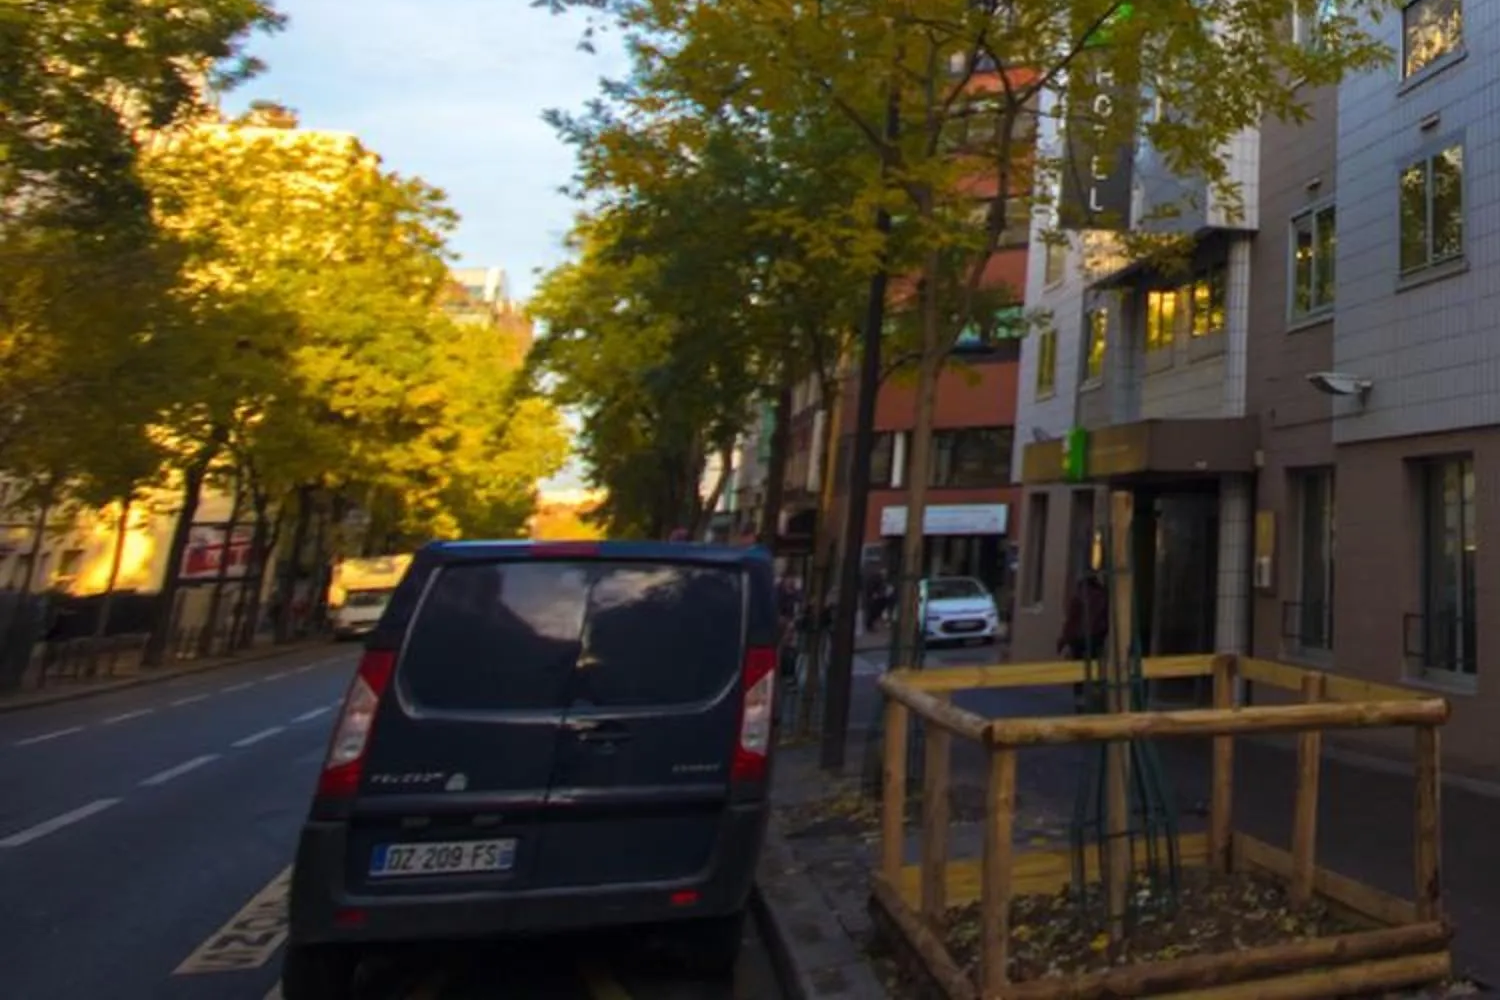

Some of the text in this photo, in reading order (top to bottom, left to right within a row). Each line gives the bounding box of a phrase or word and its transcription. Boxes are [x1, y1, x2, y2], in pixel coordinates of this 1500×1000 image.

[387, 843, 497, 871] DZ 209 FS
